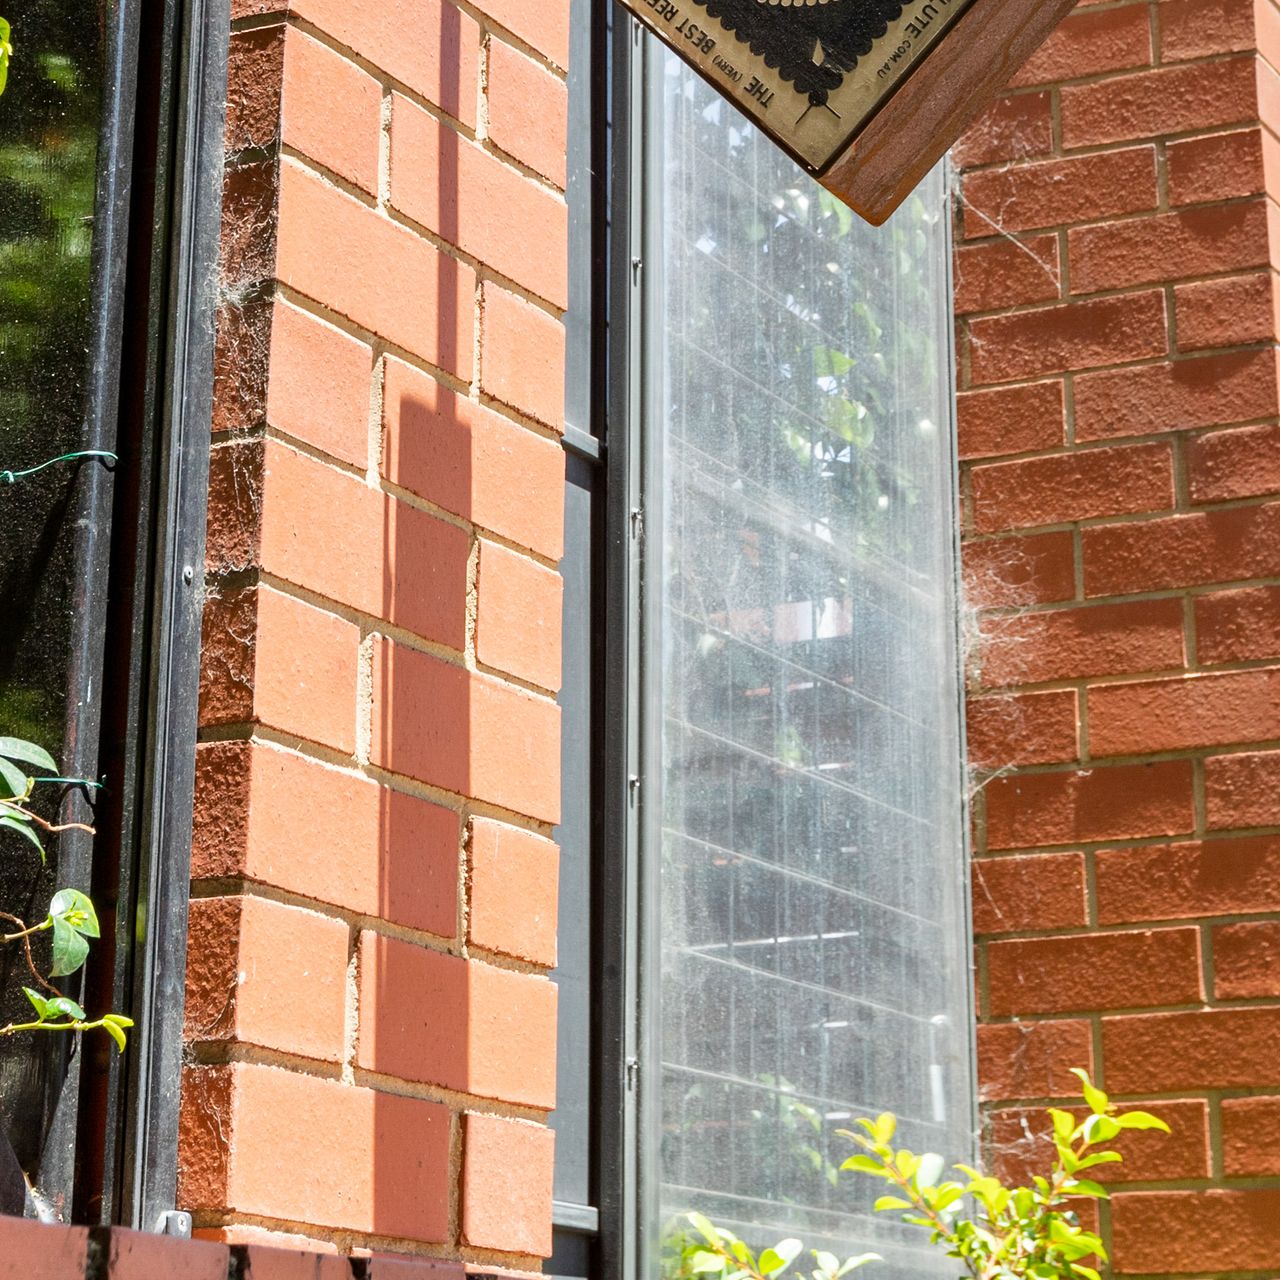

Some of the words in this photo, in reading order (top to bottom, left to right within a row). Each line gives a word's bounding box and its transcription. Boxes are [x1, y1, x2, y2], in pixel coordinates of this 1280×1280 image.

[675, 18, 717, 55] BEST
[712, 55, 744, 82] (VERY)
[744, 76, 775, 108] THE
